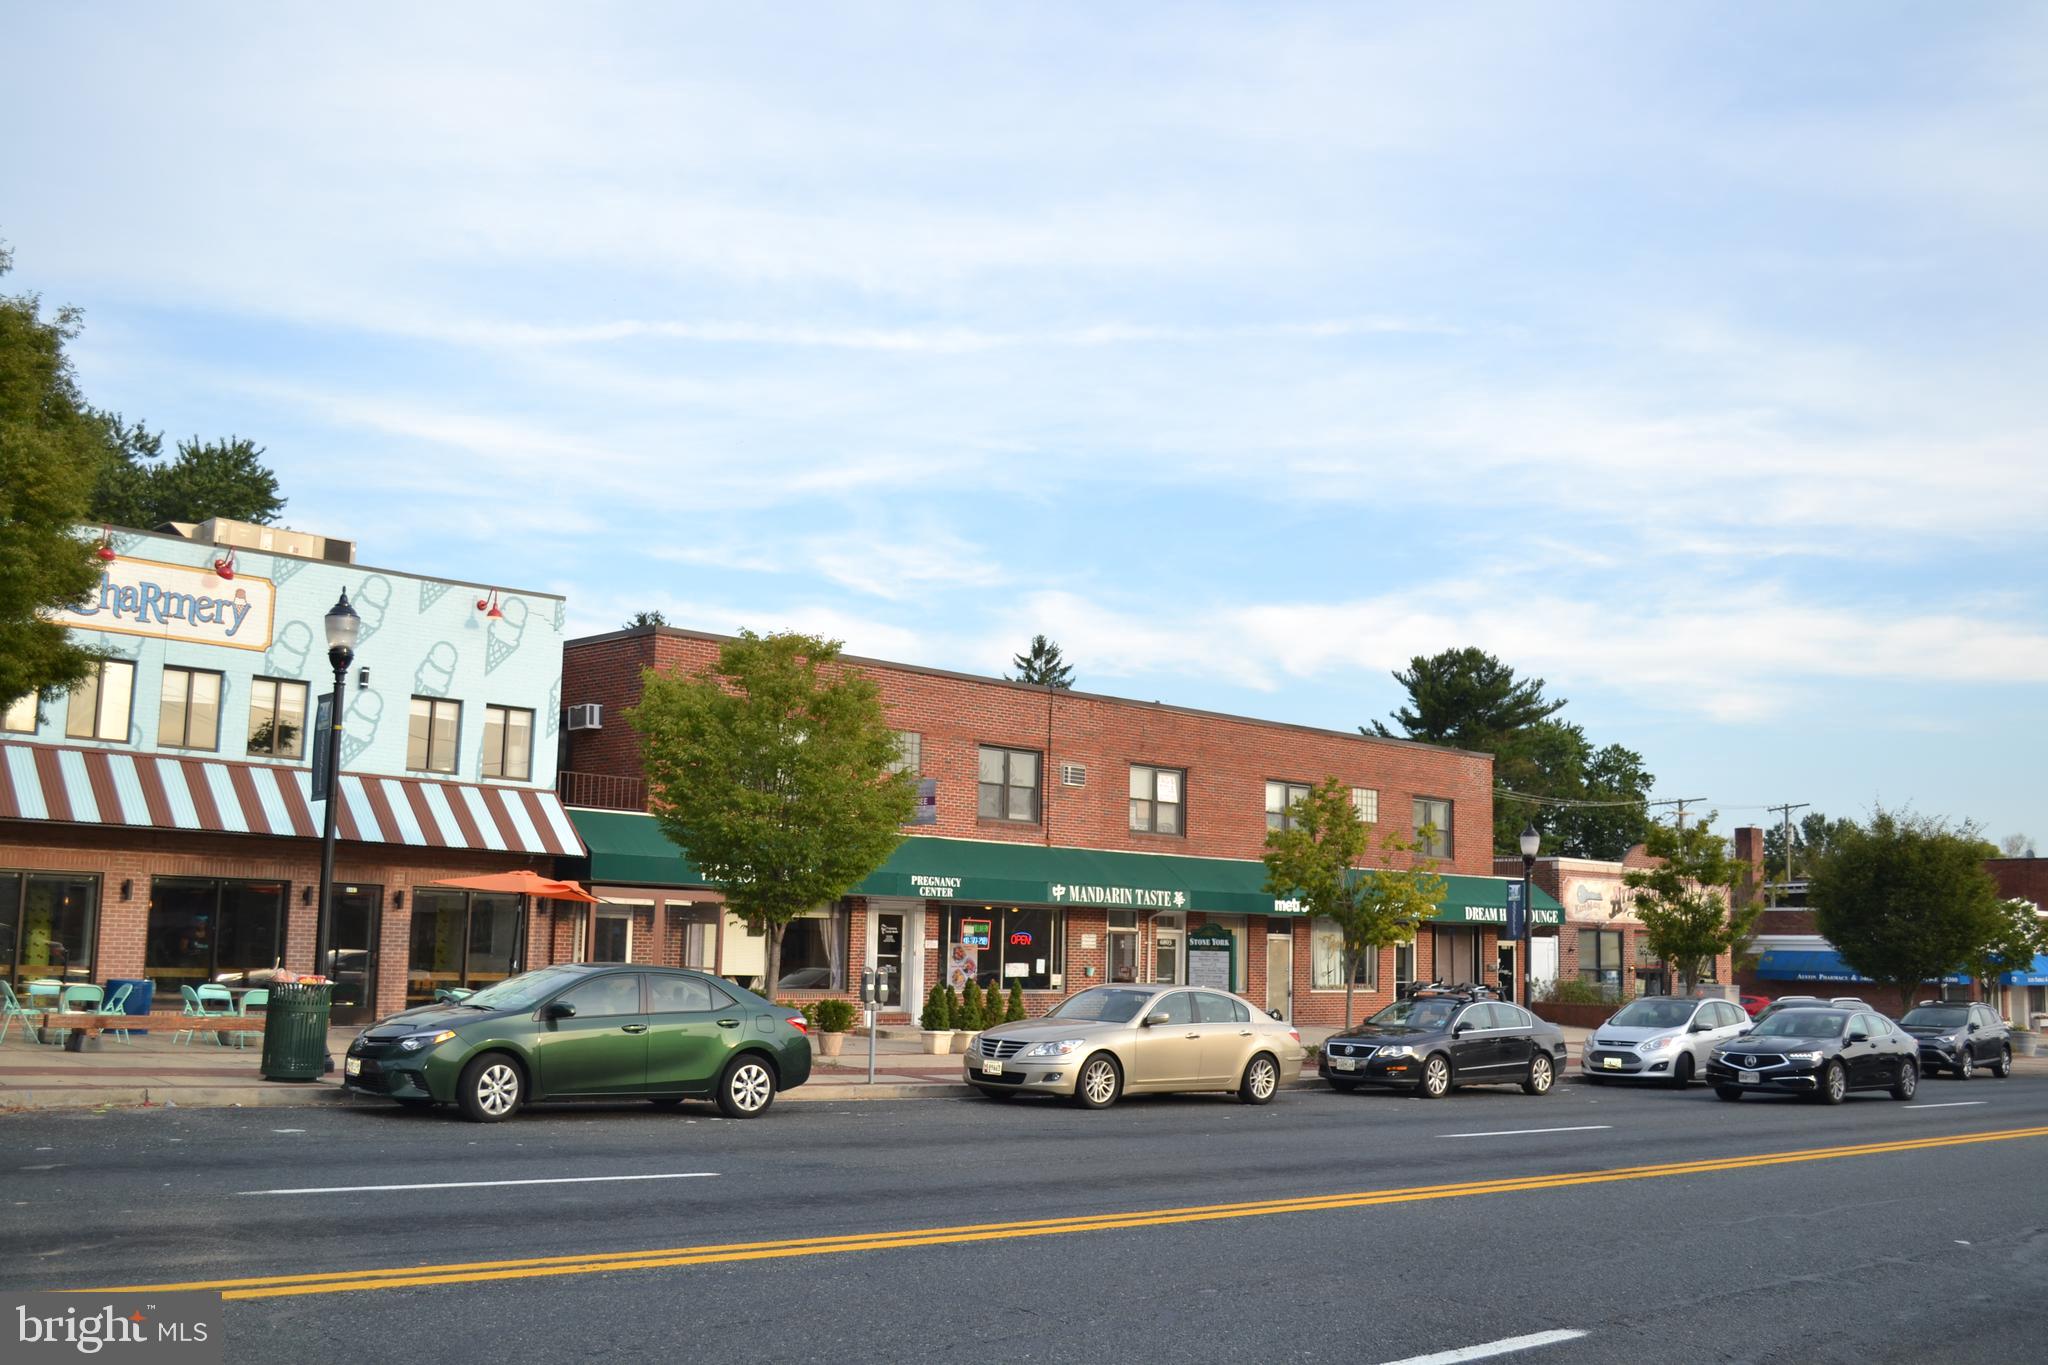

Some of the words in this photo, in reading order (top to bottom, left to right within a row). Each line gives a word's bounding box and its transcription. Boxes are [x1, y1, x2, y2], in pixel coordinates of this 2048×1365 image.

[911, 875, 961, 888] PREGNANCY
[919, 887, 953, 898] CENTER
[1069, 886, 1133, 904] MANDARIN
[1136, 889, 1171, 907] TASTE
[1465, 906, 1498, 921] DREAM
[1010, 934, 1031, 945] OPEN
[1212, 938, 1230, 946] YORK
